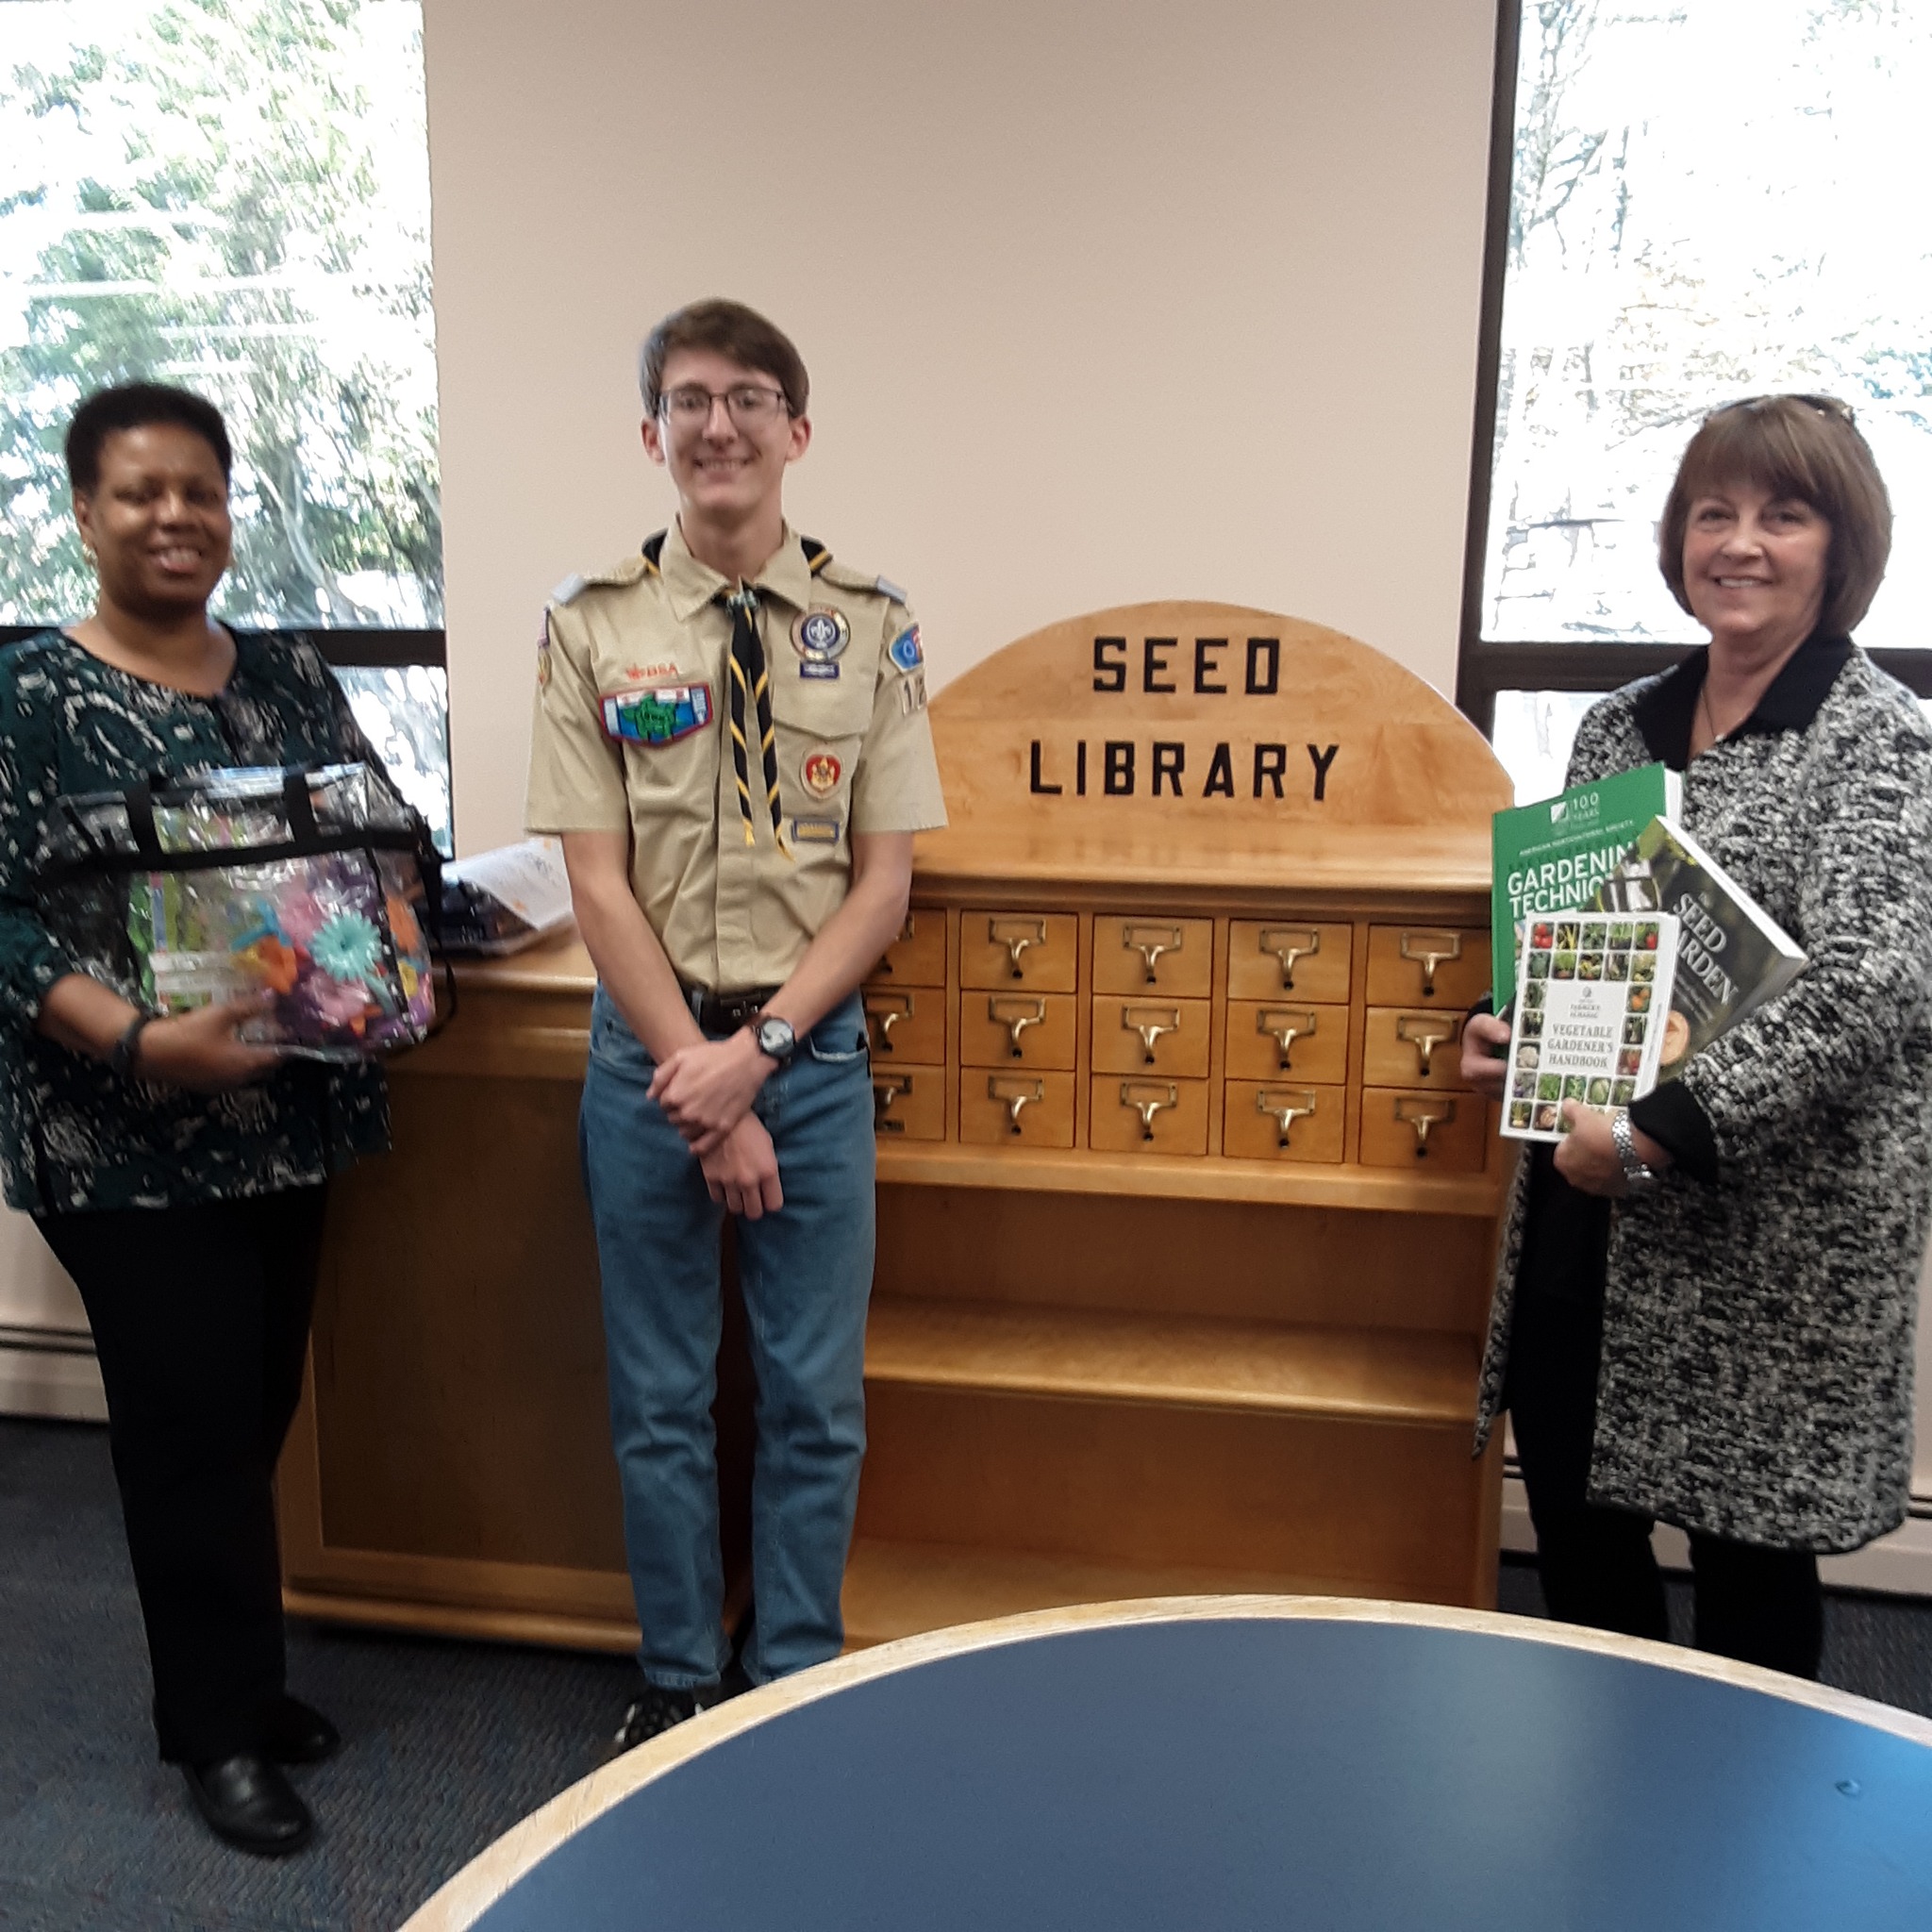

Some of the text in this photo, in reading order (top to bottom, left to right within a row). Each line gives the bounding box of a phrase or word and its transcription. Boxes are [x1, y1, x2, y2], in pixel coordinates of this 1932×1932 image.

[1092, 636, 1280, 694] SEED
[1030, 740, 1340, 801] LIBRARY
[1573, 791, 1599, 810] 100
[1673, 892, 1727, 953] SEED
[1553, 1024, 1613, 1038] VEGETABLE
[1547, 1039, 1613, 1053] GARDENER'S
[1549, 1054, 1608, 1069] HANDBOOK
